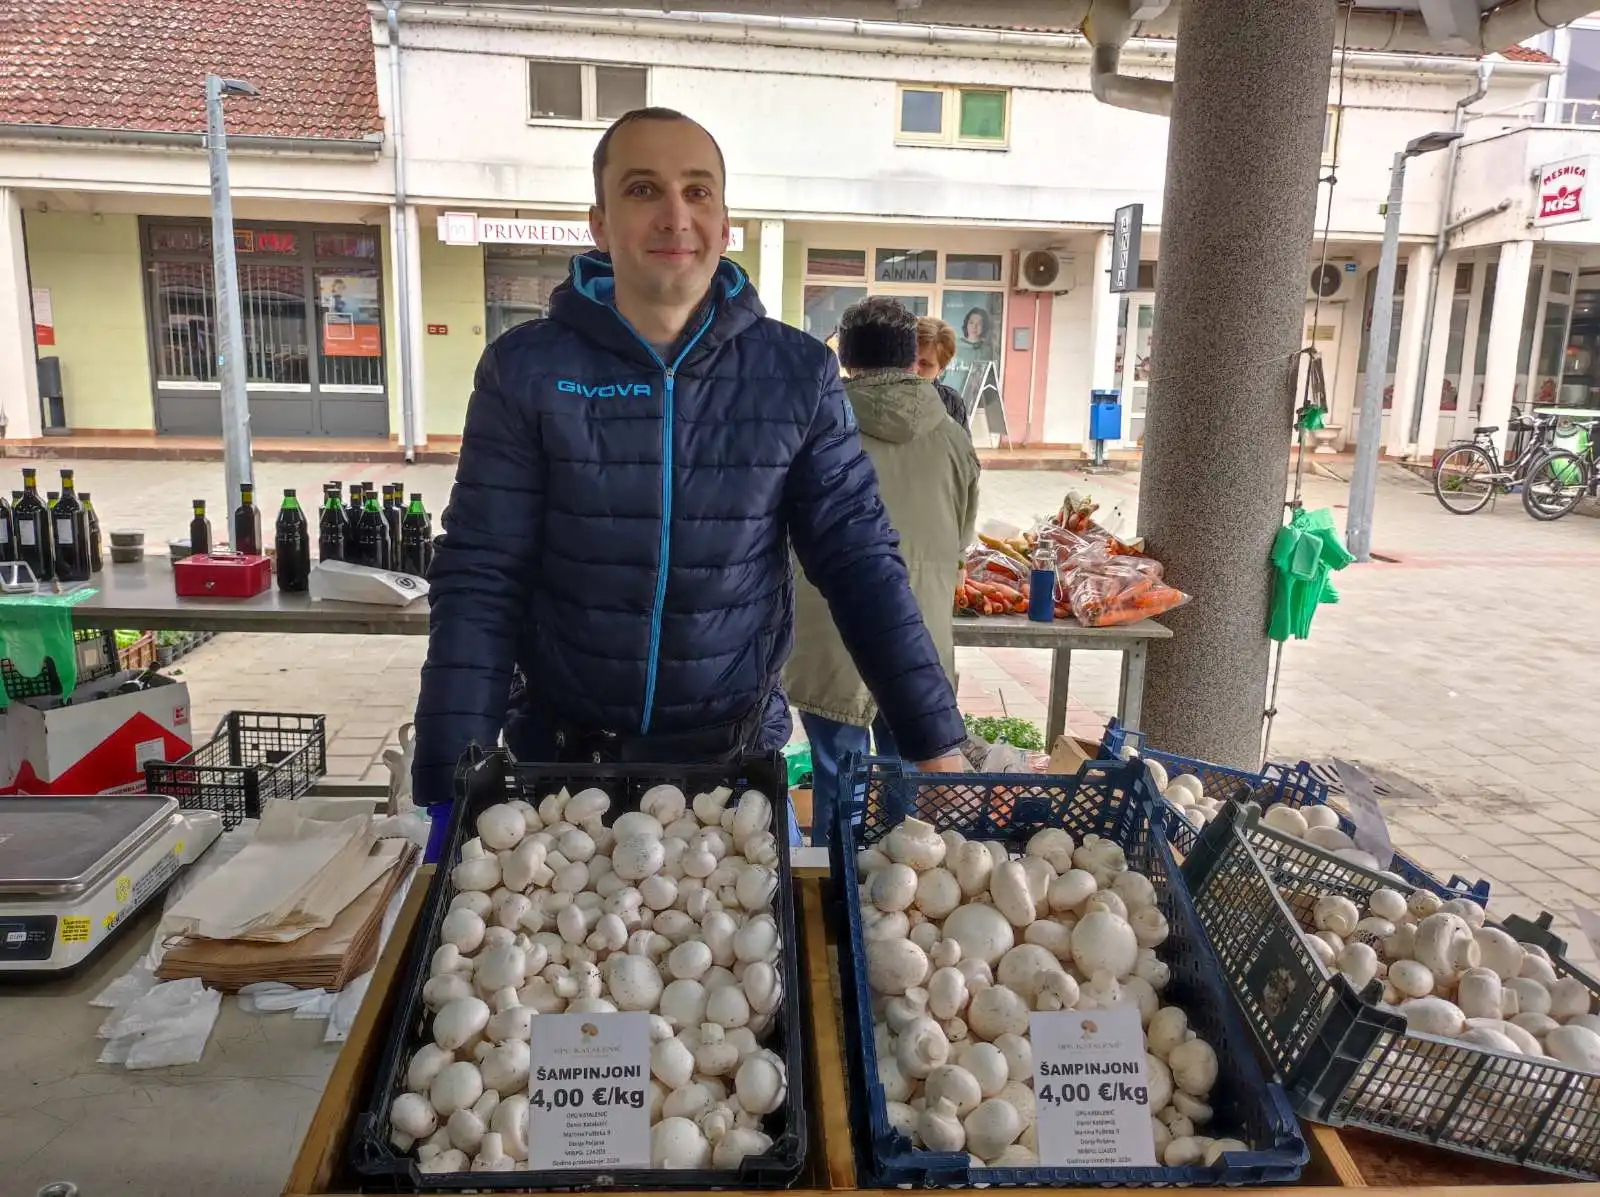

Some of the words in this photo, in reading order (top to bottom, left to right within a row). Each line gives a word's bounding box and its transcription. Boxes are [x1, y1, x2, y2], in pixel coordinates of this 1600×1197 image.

[1543, 165, 1586, 185] MESNICA
[484, 222, 593, 242] PRIVREDNA
[1117, 217, 1129, 287] ANNA
[881, 268, 928, 281] ANNA
[557, 380, 651, 398] GIVOVA
[536, 1065, 641, 1081] ŠAMPINJONI
[1040, 1061, 1139, 1076] ŠAMPINJONI
[529, 1087, 584, 1112] 4,00
[592, 1085, 644, 1109] €/kg
[1039, 1083, 1090, 1107] 4,00
[1098, 1081, 1149, 1105] €/kg
